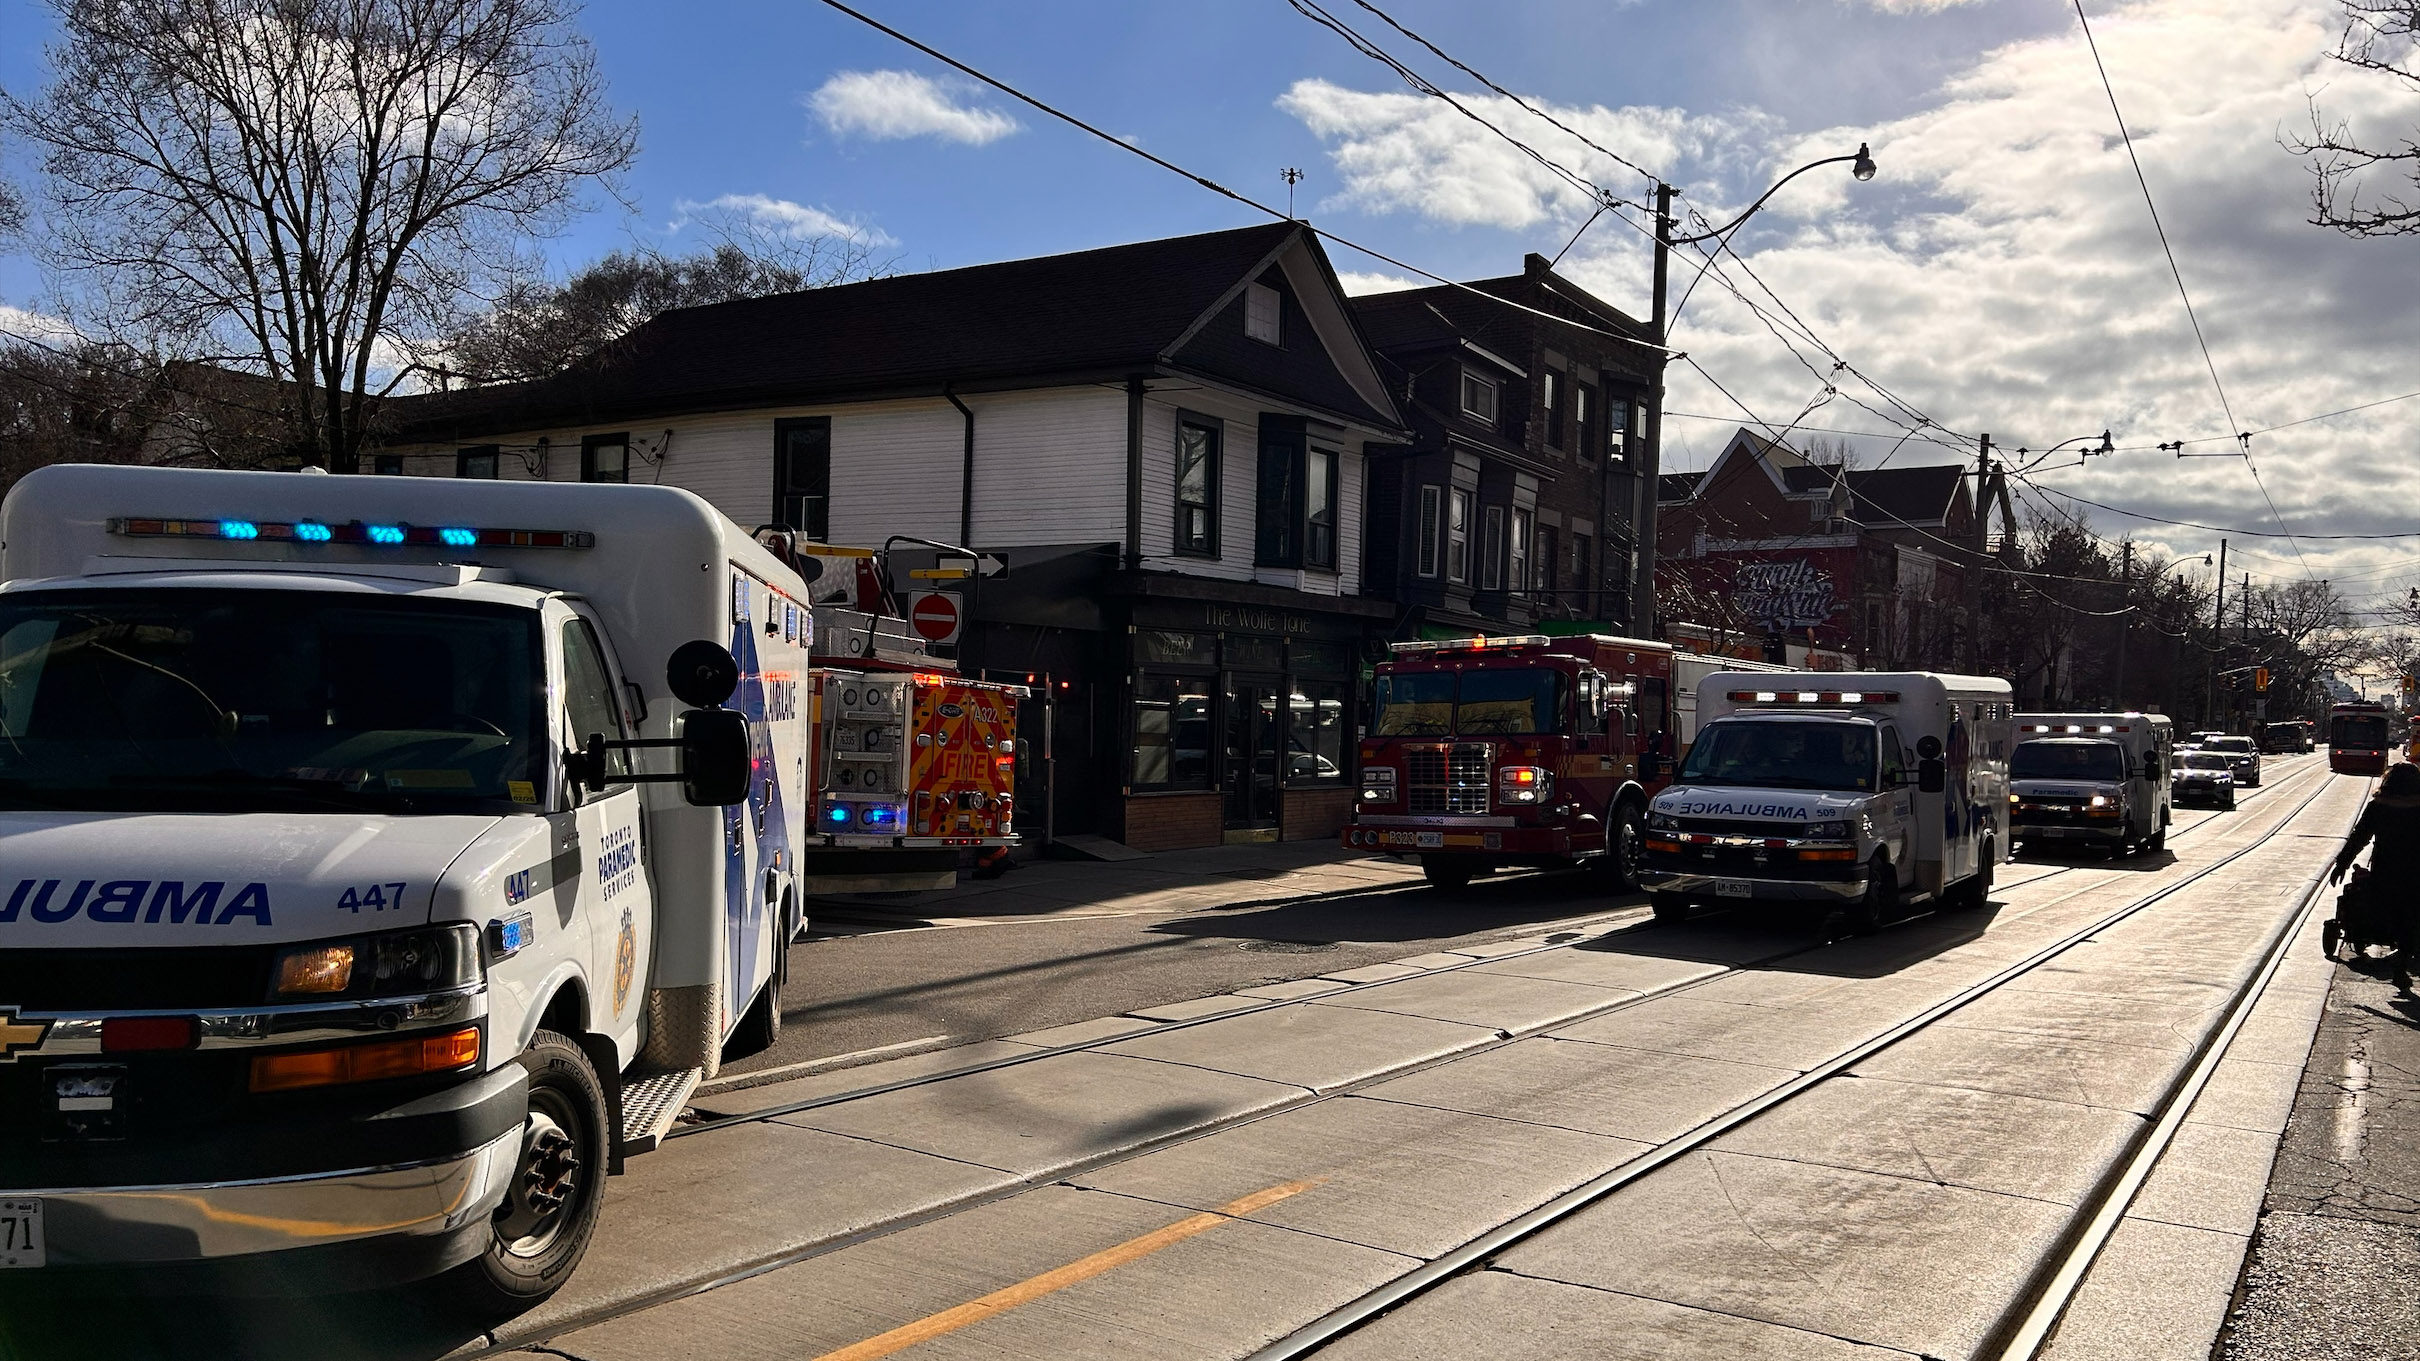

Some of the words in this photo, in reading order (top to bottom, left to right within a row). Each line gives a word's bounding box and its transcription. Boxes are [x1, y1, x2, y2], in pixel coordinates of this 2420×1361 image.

[1205, 604, 1232, 627] The
[1237, 607, 1275, 632] Wolfe
[1281, 612, 1312, 633] Tone
[974, 705, 998, 724] A322
[944, 750, 989, 780] FIRE
[1658, 801, 1674, 811] 509
[2032, 789, 2079, 797] Paramedic
[1816, 808, 1836, 818] 509
[600, 825, 632, 853] TORONTO
[1389, 830, 1415, 846] P323
[598, 840, 636, 885] PARAMEDIC
[337, 882, 408, 915] 447
[510, 868, 530, 905] 447
[603, 870, 635, 902] SERVICES
